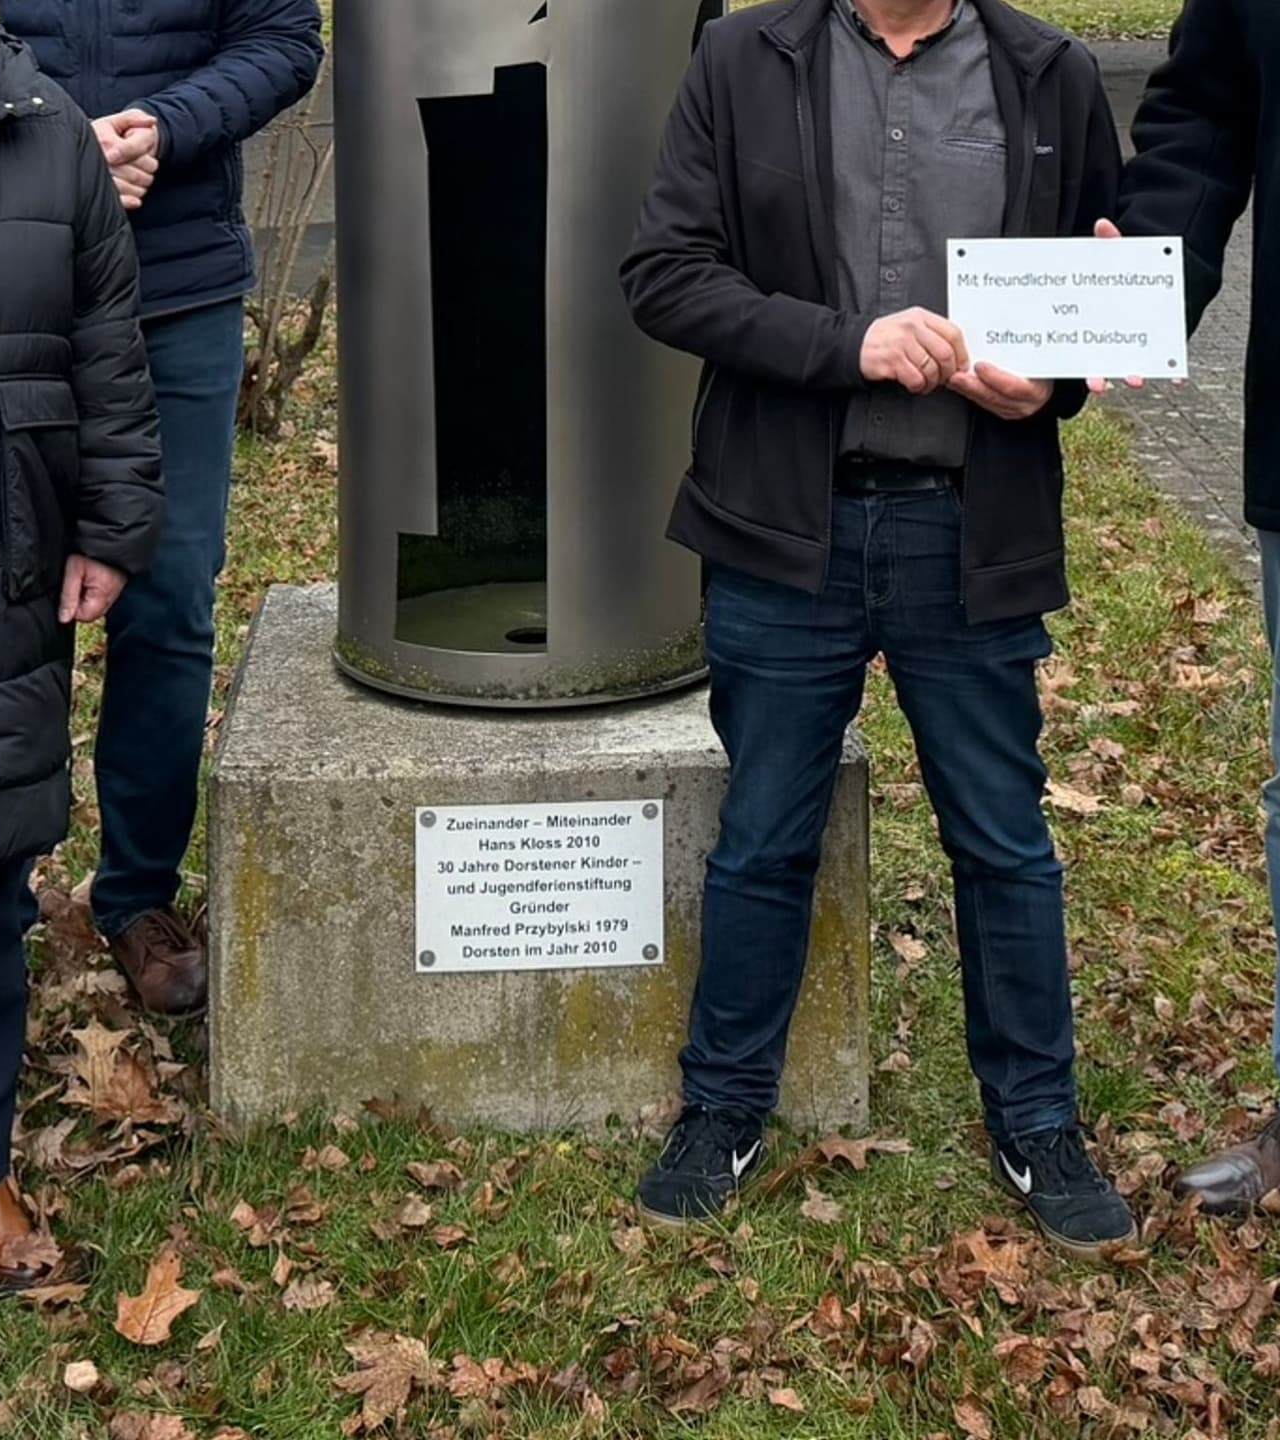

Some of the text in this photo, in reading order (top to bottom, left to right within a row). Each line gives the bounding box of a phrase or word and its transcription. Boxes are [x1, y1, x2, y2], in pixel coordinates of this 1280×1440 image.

[957, 273, 1174, 289] Mit freundlicher Unterstützung
[1052, 304, 1079, 315] von
[986, 330, 1148, 347] Stiftung Kind Duisburg
[446, 817, 529, 831] Zueinander
[546, 813, 632, 827] Miteinander
[479, 835, 601, 851] Hans Kloss 2010
[437, 861, 454, 874] 30
[458, 860, 500, 873] Jahre
[504, 858, 576, 871] Dorstener
[447, 878, 632, 897] und Jugendferienstiftung
[509, 901, 570, 914] Gründer
[450, 918, 629, 937] Manfred Przybylski 1979
[462, 940, 618, 958] Dorsten im Jahr 2010
